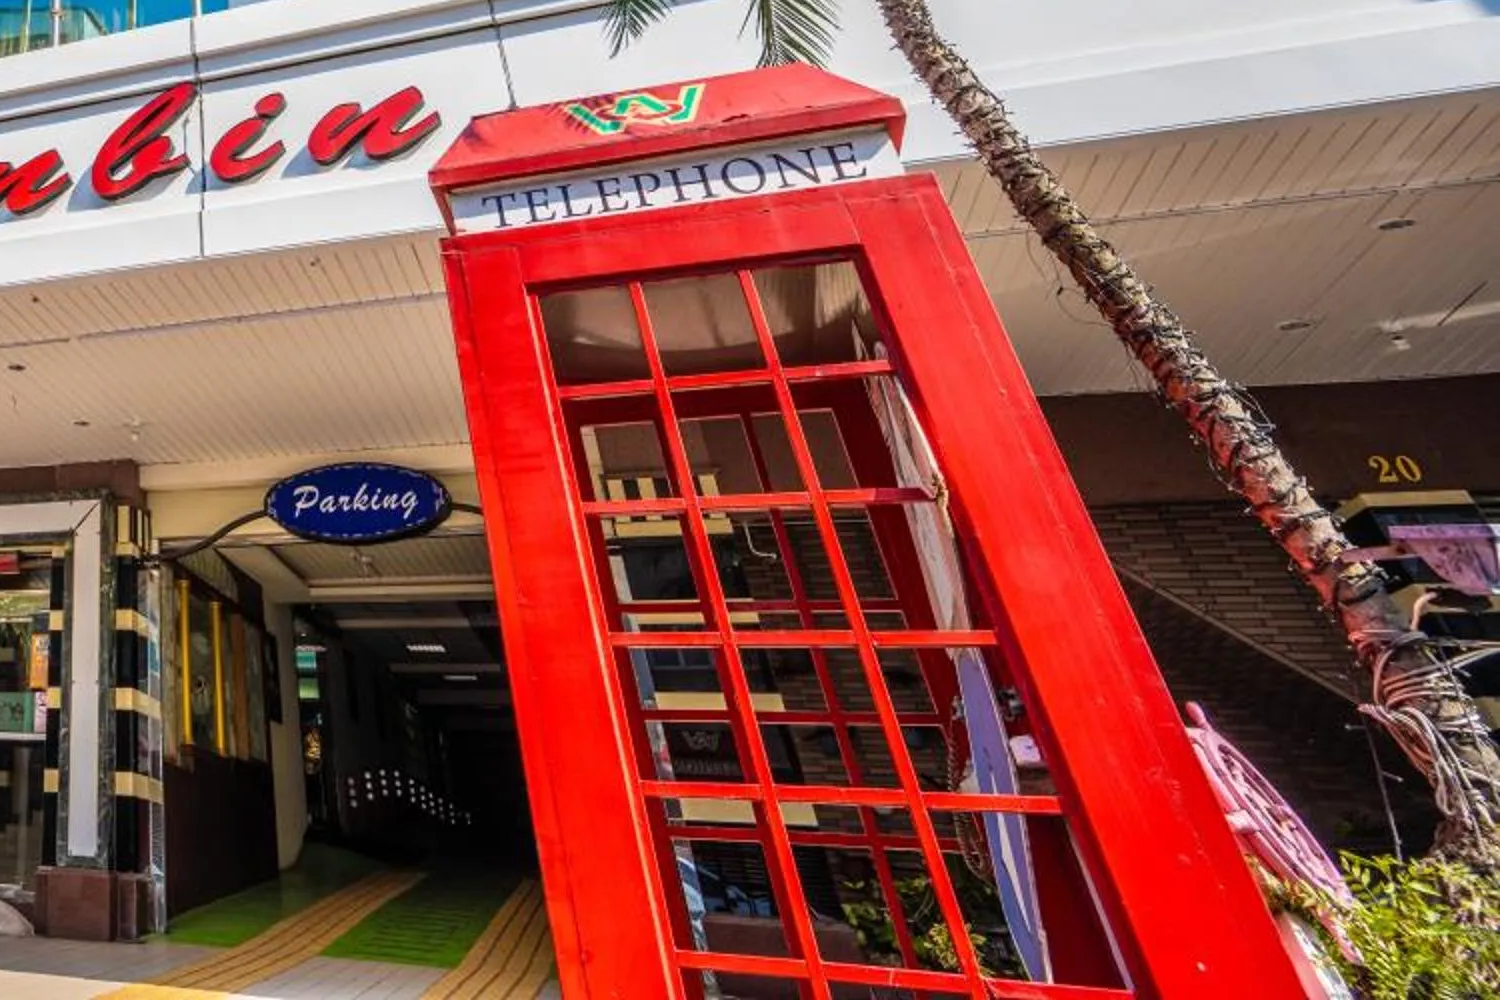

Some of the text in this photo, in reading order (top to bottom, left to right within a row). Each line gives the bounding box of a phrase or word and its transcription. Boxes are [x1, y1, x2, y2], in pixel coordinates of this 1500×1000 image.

[481, 140, 868, 229] TELEPHONE
[1367, 455, 1422, 484] 20
[292, 482, 419, 519] Parking
